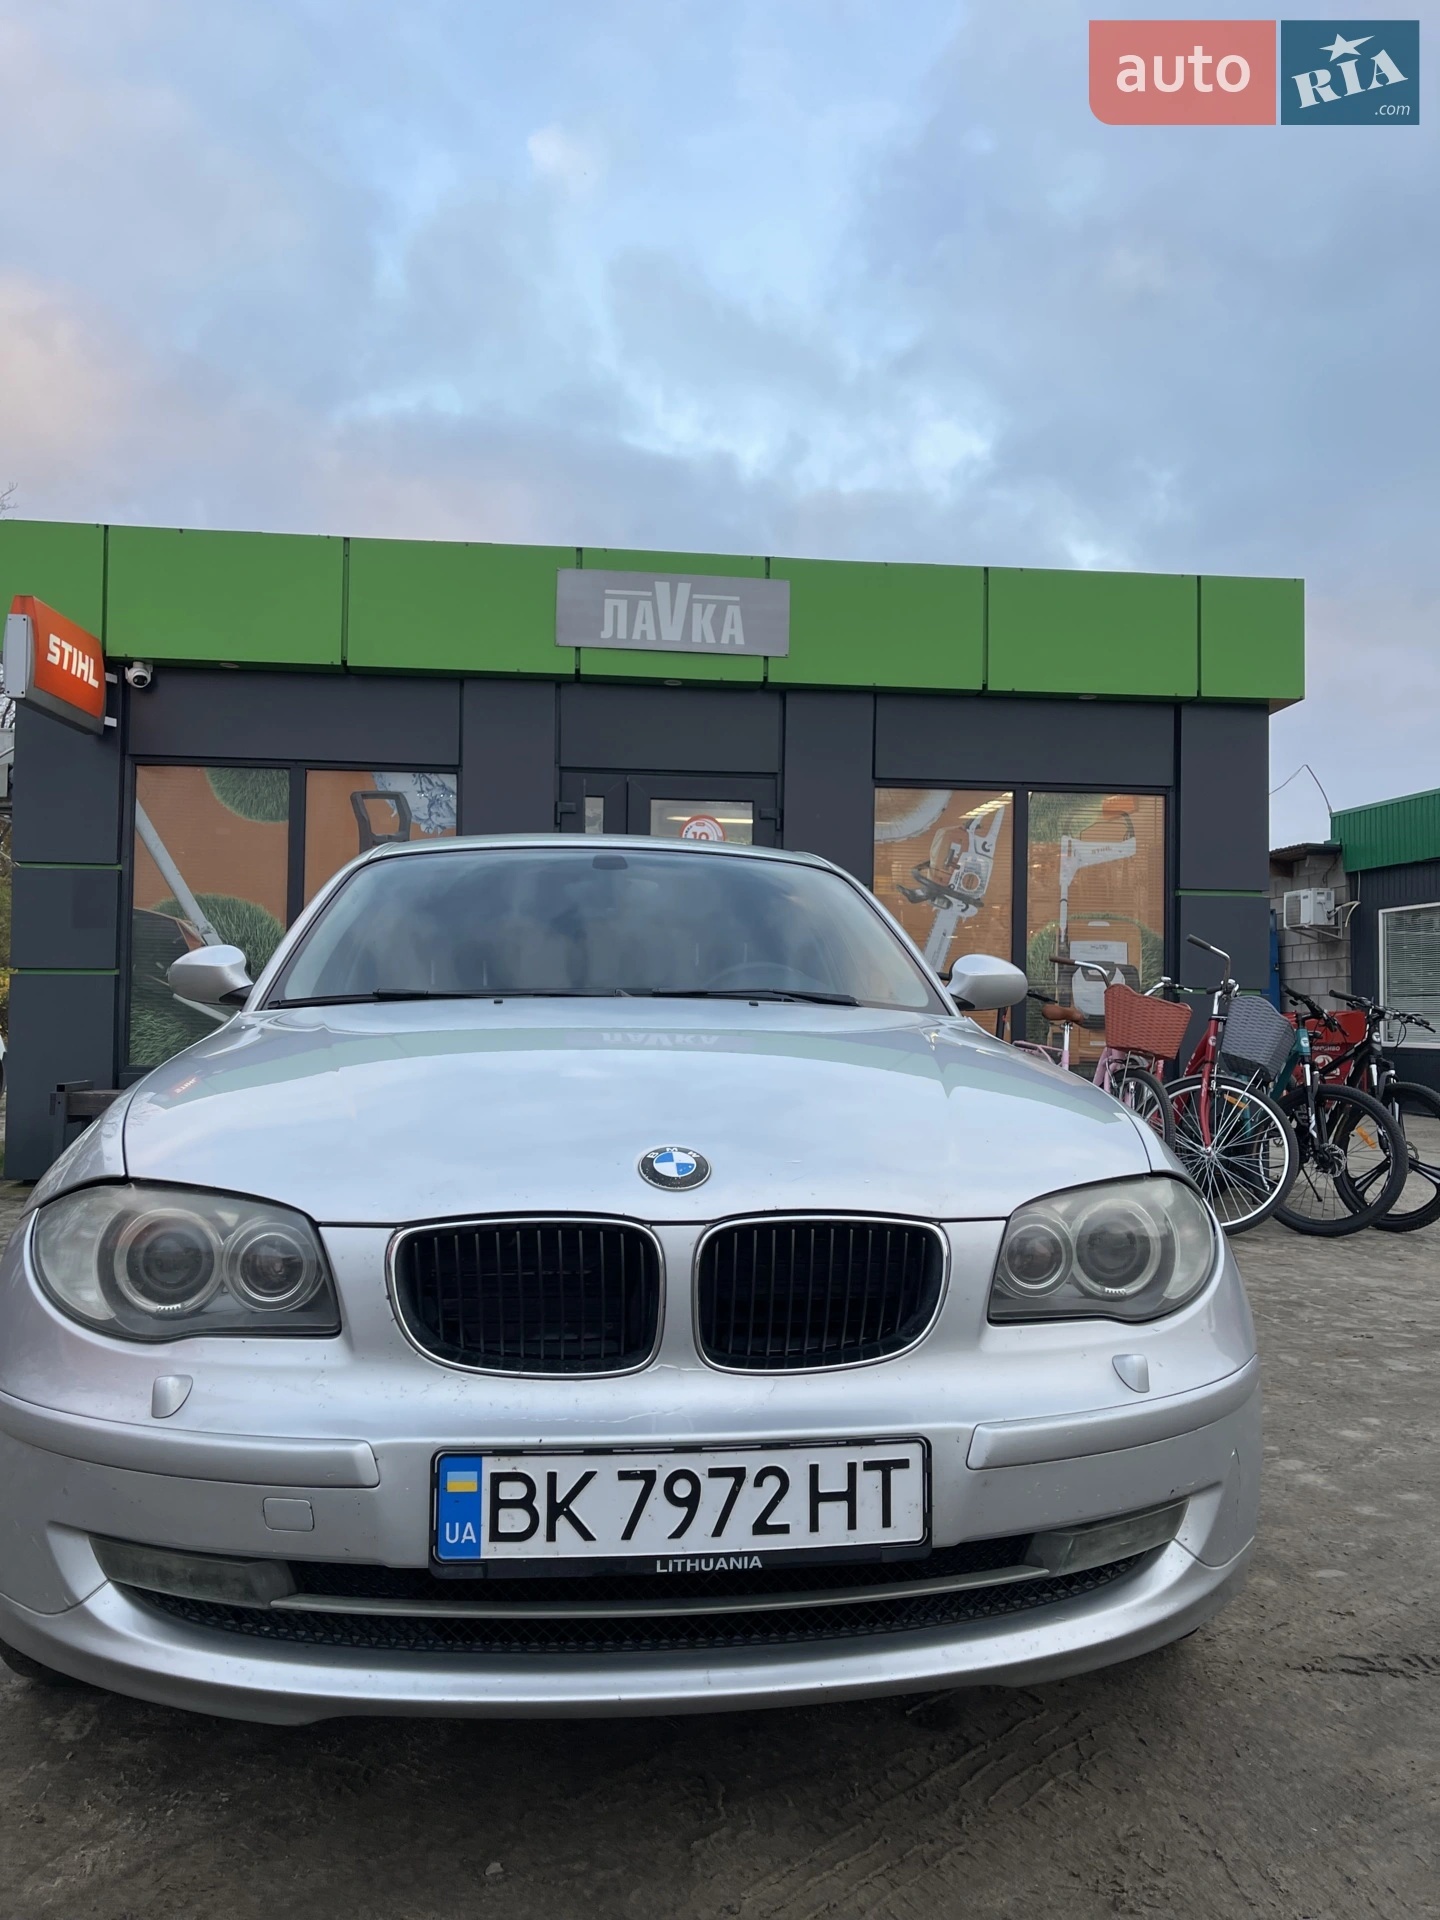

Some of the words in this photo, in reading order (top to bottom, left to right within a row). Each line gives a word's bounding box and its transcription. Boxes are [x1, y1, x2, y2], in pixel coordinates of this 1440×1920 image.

[46, 633, 99, 689] STIHL
[646, 1147, 701, 1159] BMW
[489, 1470, 598, 1543] BK
[617, 1465, 790, 1541] 7972
[809, 1458, 910, 1533] HT
[445, 1522, 477, 1544] UA
[656, 1555, 763, 1573] LITHUANIA
